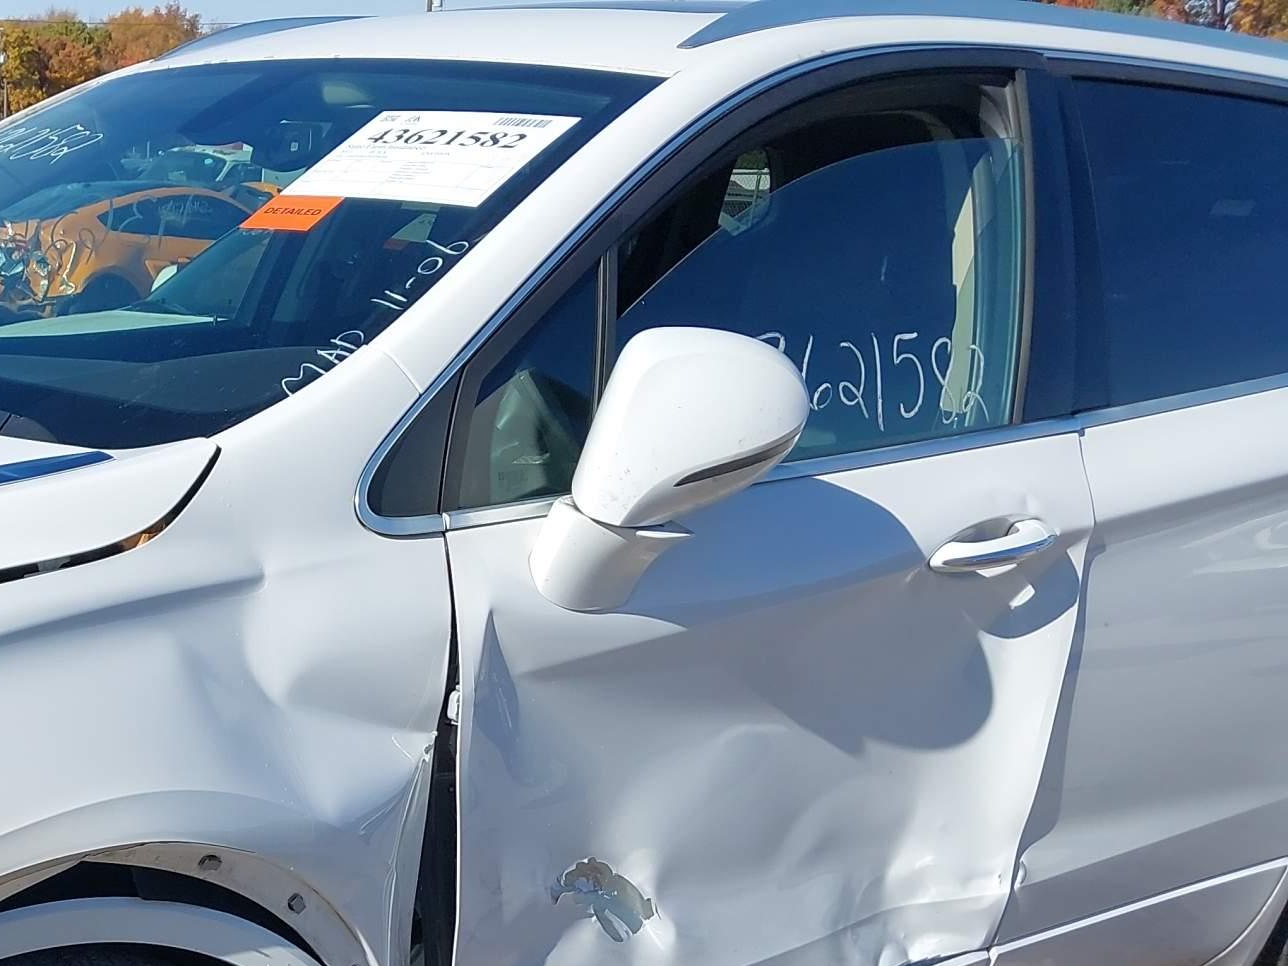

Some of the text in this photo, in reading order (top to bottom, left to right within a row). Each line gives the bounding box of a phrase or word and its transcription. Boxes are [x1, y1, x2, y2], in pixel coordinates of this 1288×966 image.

[368, 128, 528, 149] 43621582
[264, 207, 323, 216] DETAILED
[369, 240, 470, 311] 11-06
